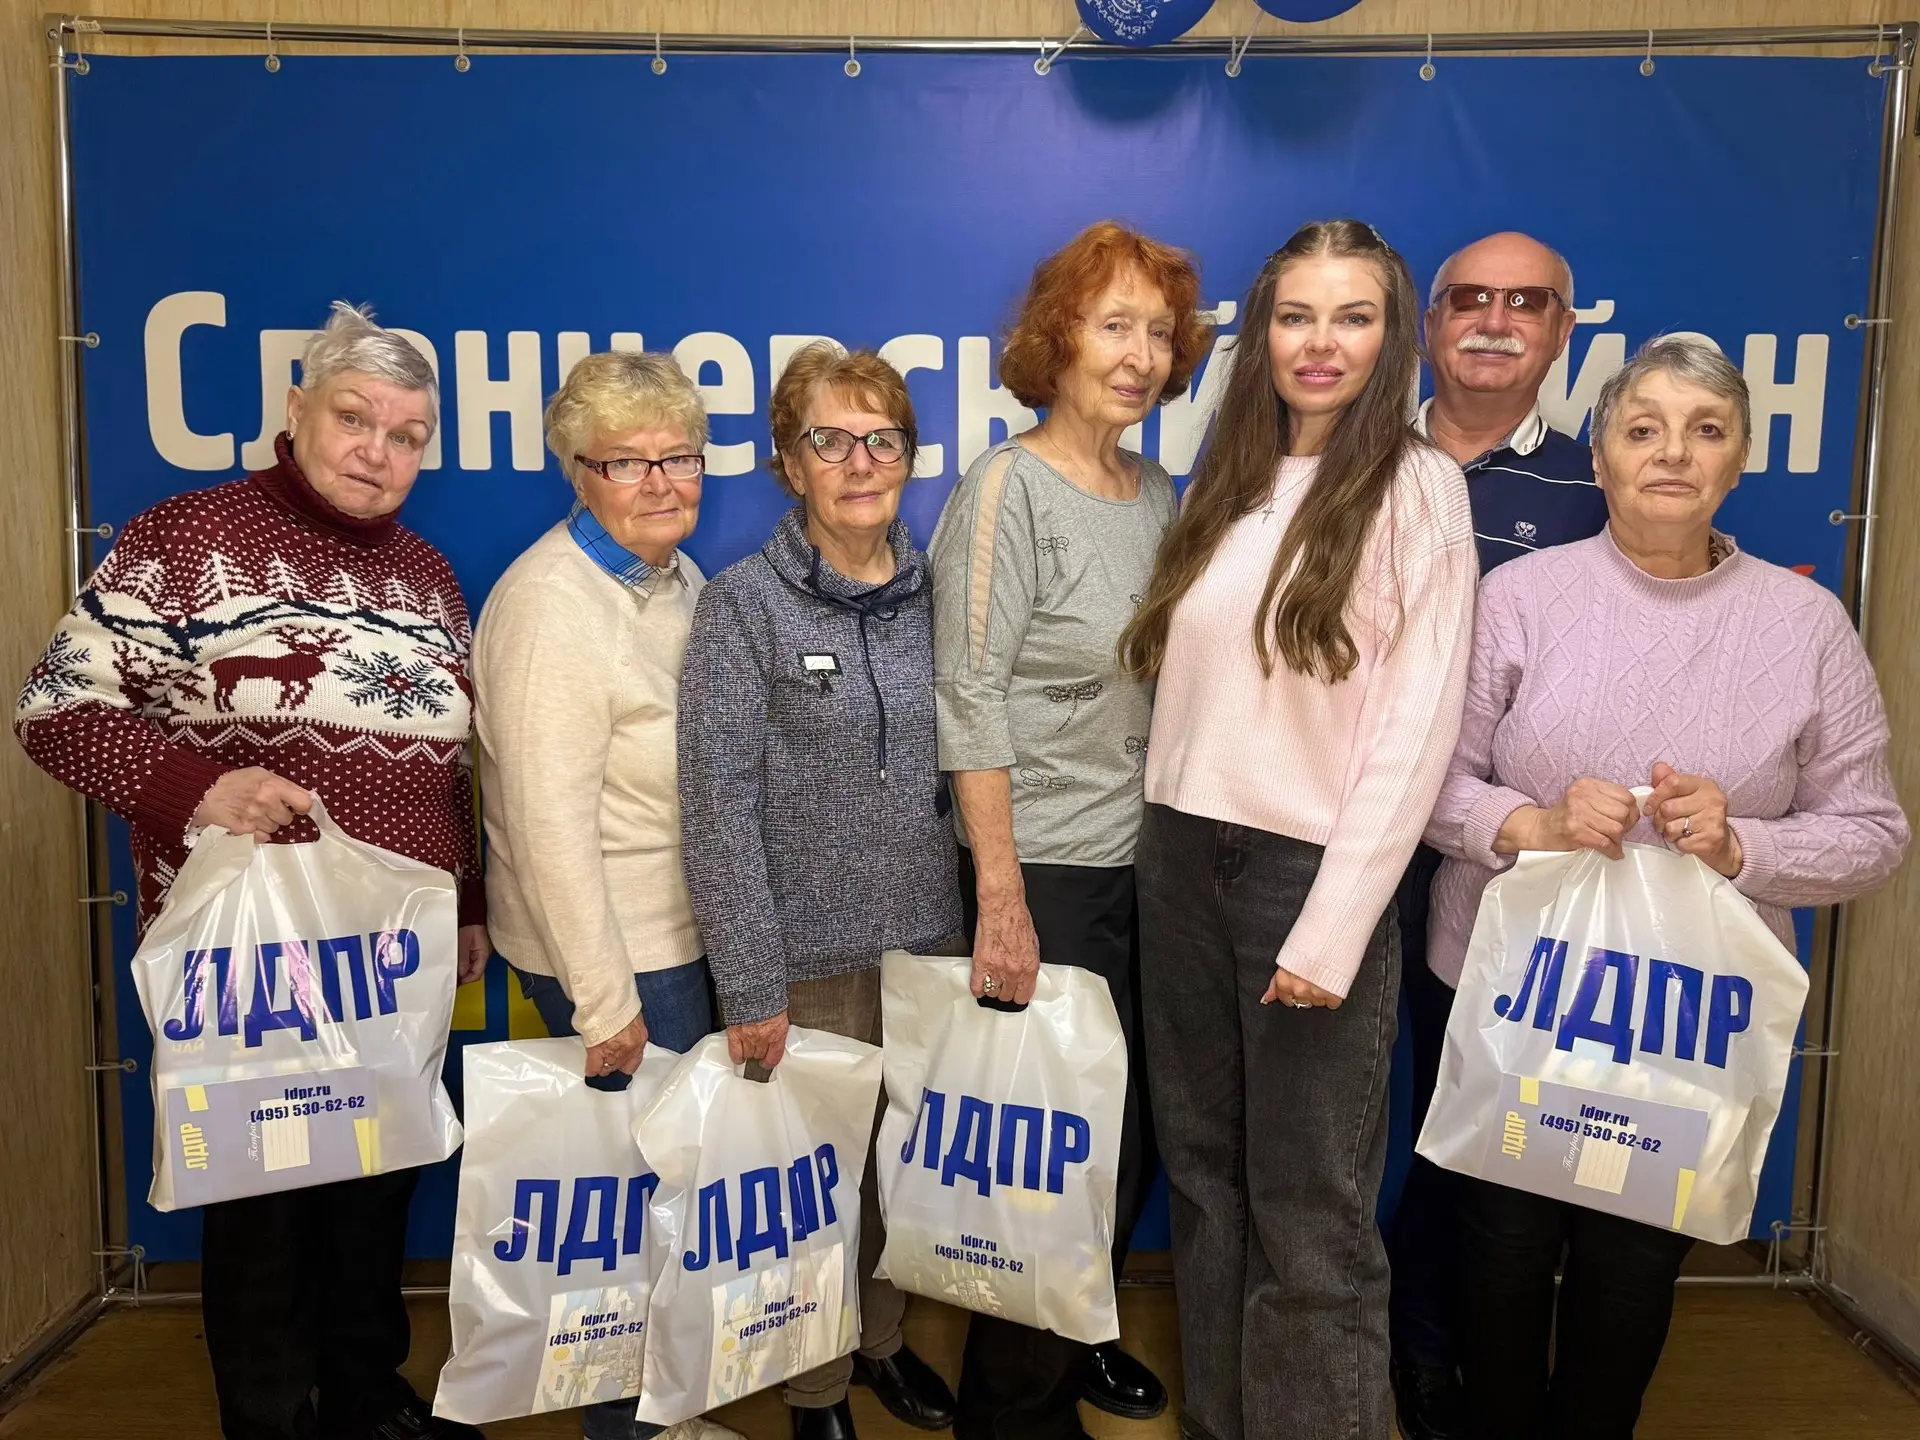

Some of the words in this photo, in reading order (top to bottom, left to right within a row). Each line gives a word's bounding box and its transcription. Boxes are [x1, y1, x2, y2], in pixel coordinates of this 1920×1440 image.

[163, 928, 420, 1048] ЛДПР
[1493, 936, 1754, 1069] ЛДПР
[284, 1085, 331, 1101] ldpr.ru
[250, 1106, 289, 1123] (495)
[292, 1096, 365, 1117] 530-62-62
[1579, 1103, 1630, 1127] ldpr.ru
[180, 1122, 209, 1170] ЛДПР
[900, 1086, 1091, 1198] ЛДПР
[1501, 1110, 1528, 1160] ЛДПР
[1539, 1113, 1581, 1134] (495)
[1582, 1123, 1662, 1153] 530-62-62
[682, 1143, 840, 1271] ЛДПР
[960, 1234, 998, 1252] ldpr.ru
[935, 1244, 964, 1260] (495)
[966, 1251, 1024, 1274] 530-62-62
[549, 1331, 582, 1347] (495)
[583, 1321, 644, 1341] 530-62-62
[581, 1311, 619, 1327] ldpr.ru
[739, 1319, 767, 1340] (495)
